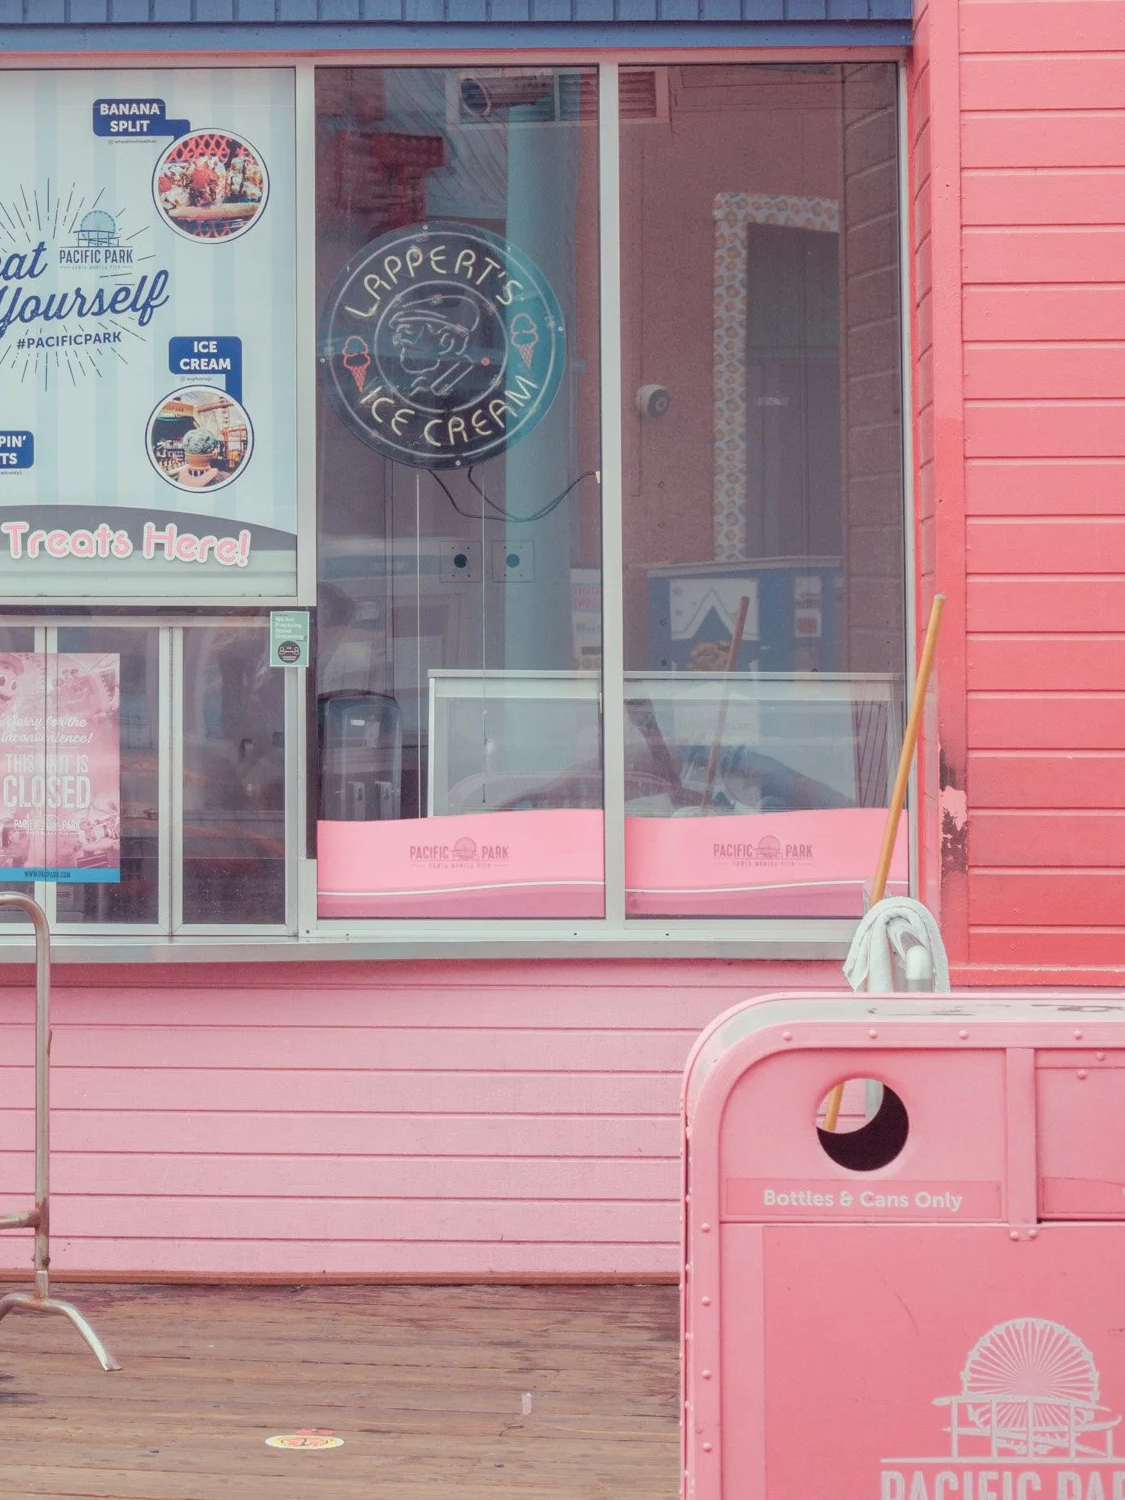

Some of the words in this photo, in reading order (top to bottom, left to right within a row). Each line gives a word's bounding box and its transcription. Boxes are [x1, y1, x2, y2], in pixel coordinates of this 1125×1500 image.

[99, 103, 161, 116] BANANA
[110, 120, 151, 133] SPLIT
[59, 249, 101, 264] PACIFIC
[104, 249, 134, 264] PARK
[344, 244, 524, 318] LAPPERT'S
[16, 331, 123, 350] #PACIFICPARK
[193, 340, 218, 353] ICE
[179, 358, 231, 370] CREAM
[359, 385, 416, 437] ICE
[424, 375, 539, 447] CREAM
[1, 521, 134, 560] Treats
[142, 521, 252, 568] Here!
[6, 714, 43, 729] Sorry
[67, 716, 88, 728] the
[1, 731, 94, 744] inconvenience!
[4, 753, 36, 773] THIS
[76, 754, 89, 773] IS
[2, 774, 92, 809] CLOSED
[409, 845, 449, 860] PACIFIC
[481, 845, 509, 860] PARK
[713, 843, 753, 858] PACIFIC
[785, 843, 813, 858] PARK
[763, 1189, 834, 1208] Bottles
[839, 1190, 854, 1208] &
[860, 1190, 909, 1208] Cans
[915, 1190, 963, 1213] Only
